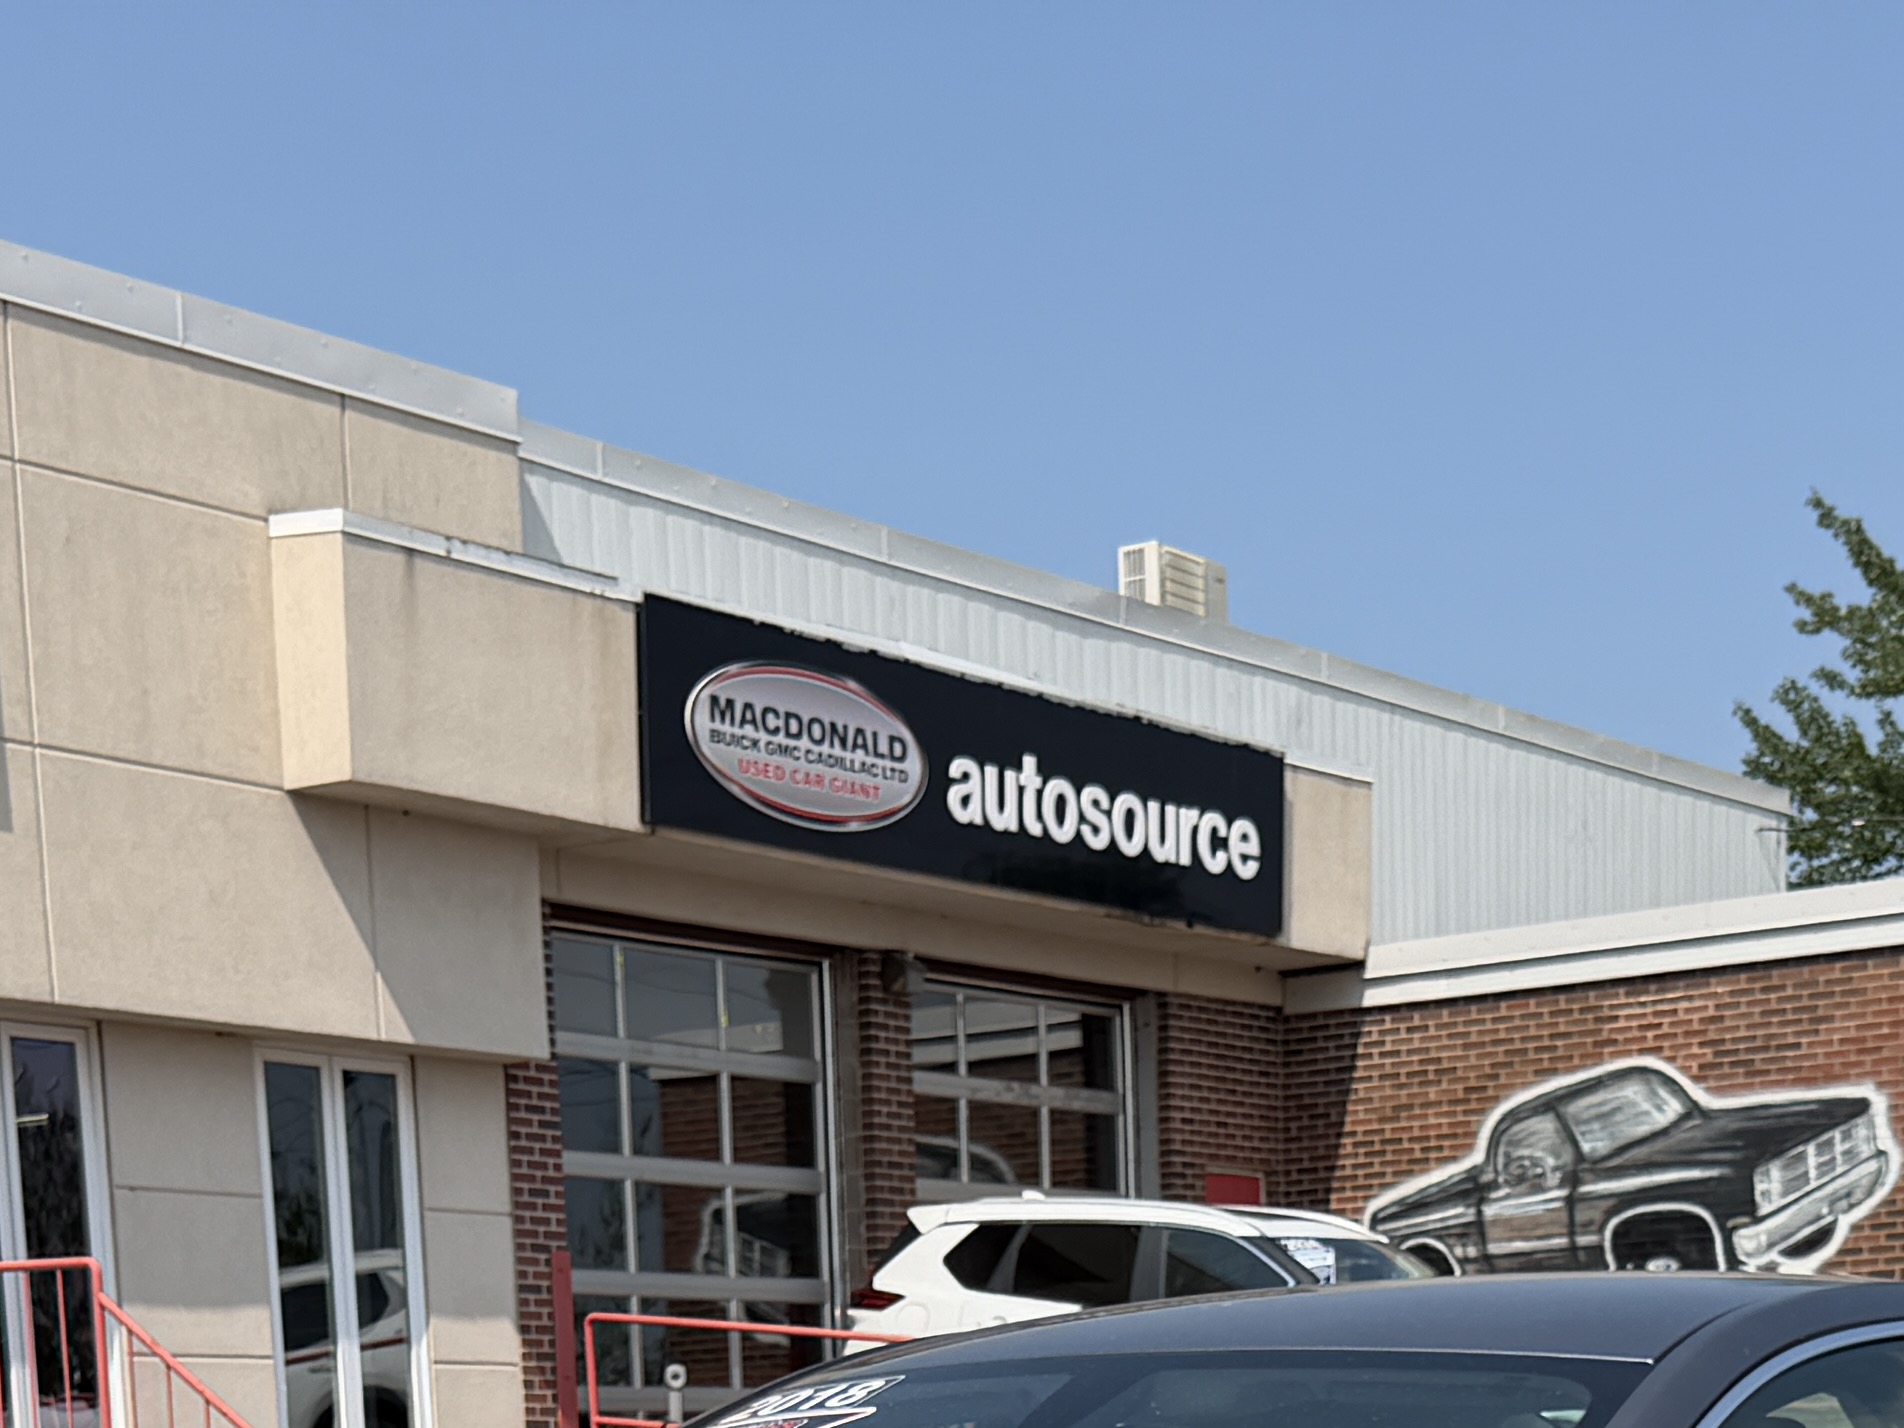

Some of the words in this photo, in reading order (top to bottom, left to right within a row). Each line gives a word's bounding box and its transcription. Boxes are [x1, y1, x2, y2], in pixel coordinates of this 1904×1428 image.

[708, 694, 909, 764] MACDONALD
[708, 728, 762, 752] BUICK
[764, 740, 802, 762] GMC
[804, 748, 880, 779] CADILLAC
[881, 766, 910, 784] LTD
[737, 757, 787, 782] USED
[790, 768, 826, 791] CAR
[828, 777, 882, 803] GIANT
[946, 751, 1262, 881] autosource
[719, 1379, 887, 1425] 2018
